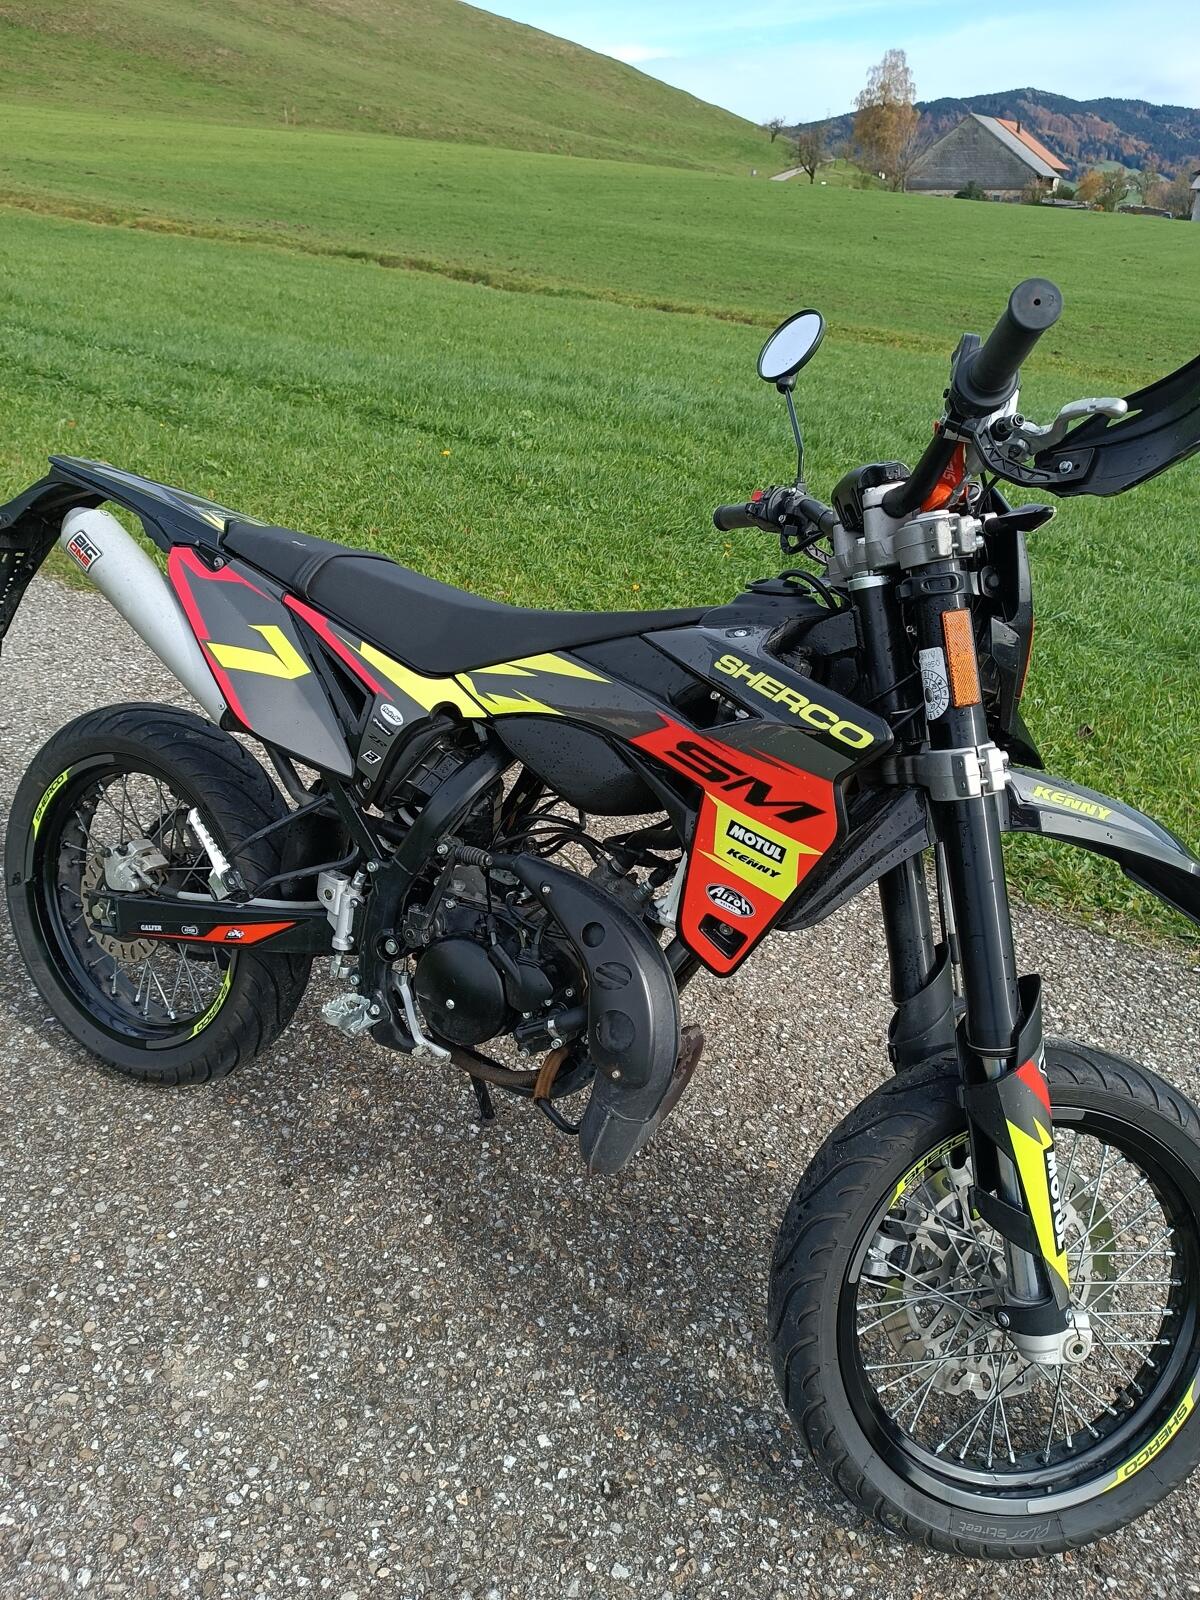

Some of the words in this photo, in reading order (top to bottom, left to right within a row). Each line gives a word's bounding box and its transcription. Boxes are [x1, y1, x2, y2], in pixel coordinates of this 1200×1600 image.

[70, 542, 91, 567] ONE
[73, 534, 98, 561] BIG
[714, 654, 875, 749] SHERCO
[36, 774, 64, 821] SHERCO
[664, 741, 827, 823] SM
[1033, 785, 1112, 820] KENNY
[729, 823, 783, 861] MOTUL
[726, 848, 781, 878] KENNY
[709, 887, 750, 915] Airoh
[140, 924, 162, 932] GALFER
[904, 1132, 969, 1185] SHERC
[1124, 1403, 1188, 1476] SHERCO
[959, 1521, 1007, 1538] Street
